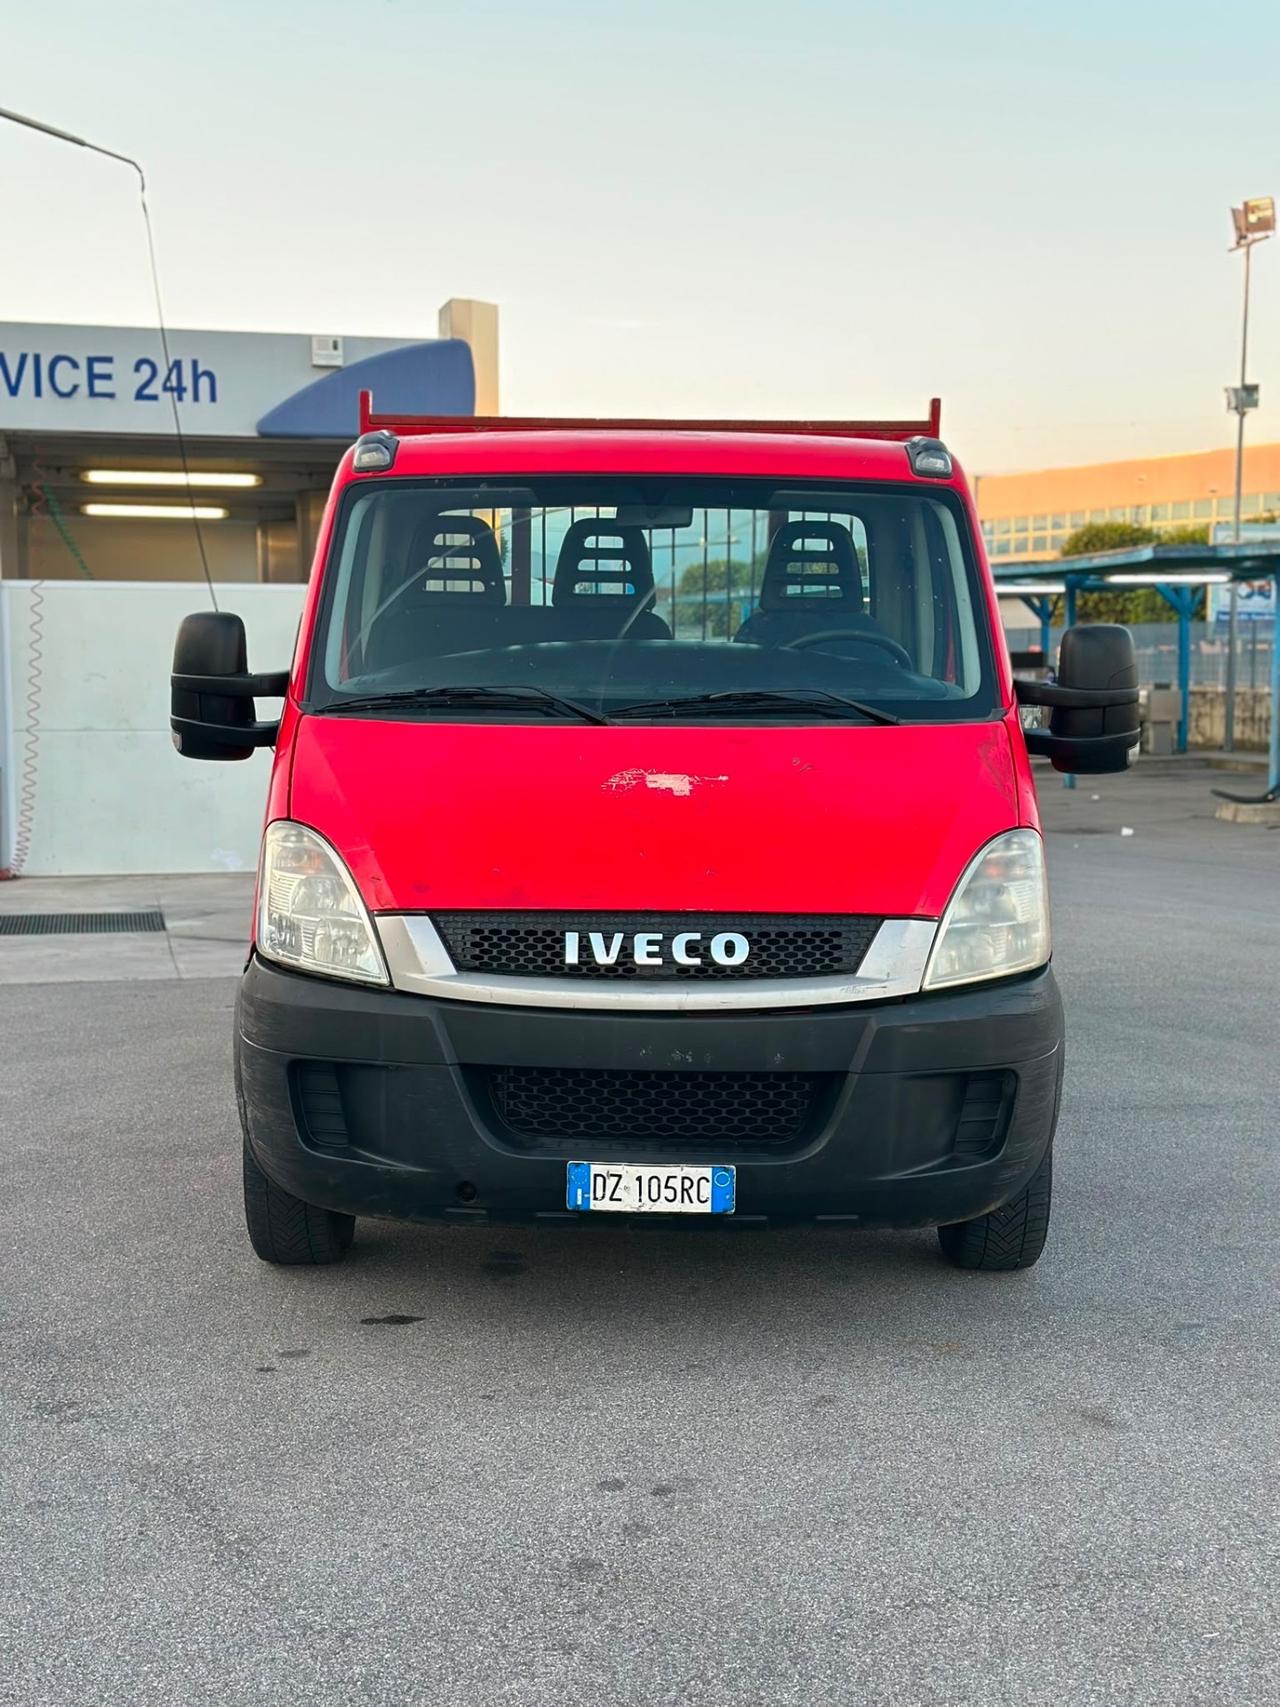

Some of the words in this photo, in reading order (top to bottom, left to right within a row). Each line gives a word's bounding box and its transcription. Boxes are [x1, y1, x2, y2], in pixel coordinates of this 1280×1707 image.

[0, 352, 116, 399] VICE
[133, 357, 217, 402] 24h
[565, 932, 750, 966] IVECO
[593, 1173, 623, 1202] DZ
[635, 1175, 711, 1204] 105RC
